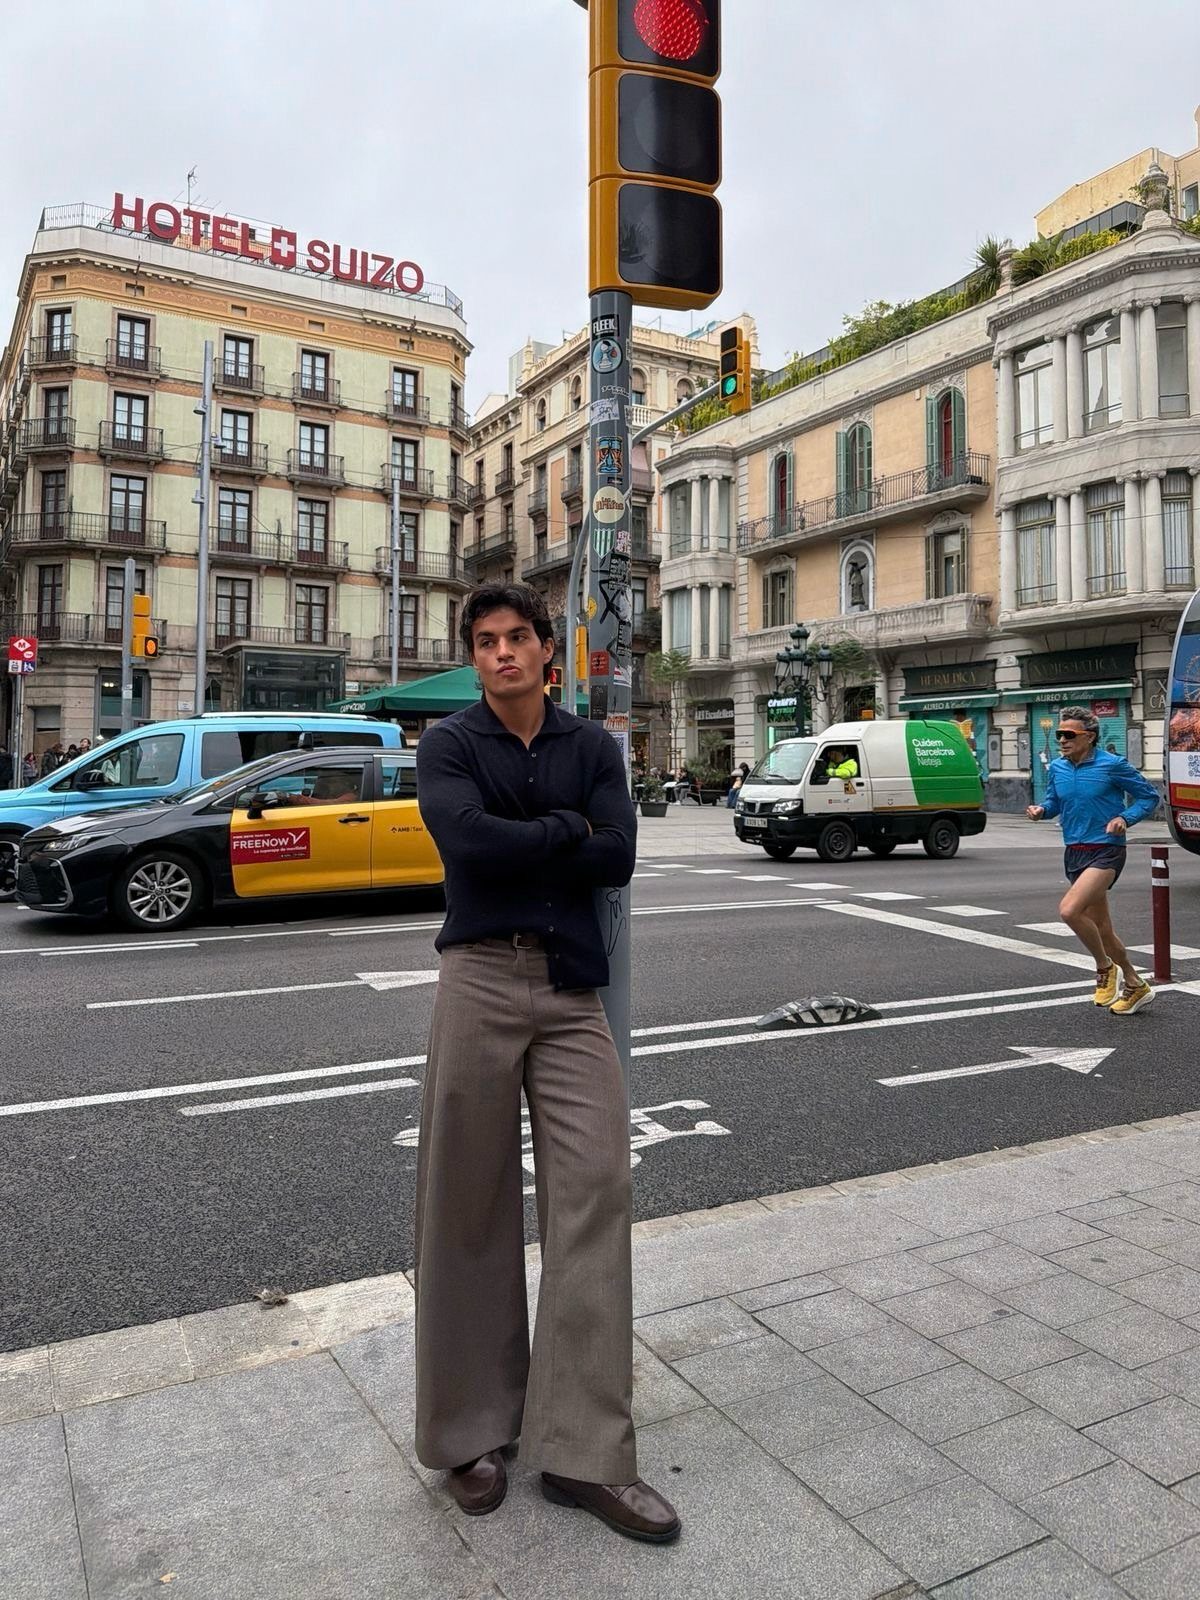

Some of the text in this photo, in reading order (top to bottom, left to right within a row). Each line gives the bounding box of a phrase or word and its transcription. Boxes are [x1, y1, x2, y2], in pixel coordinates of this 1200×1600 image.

[114, 192, 425, 294] HOTEL SUIZO
[911, 738, 944, 747] Cuidem
[914, 747, 956, 756] Barcelona
[916, 756, 943, 767] Neteja
[232, 837, 290, 850] FREENOW
